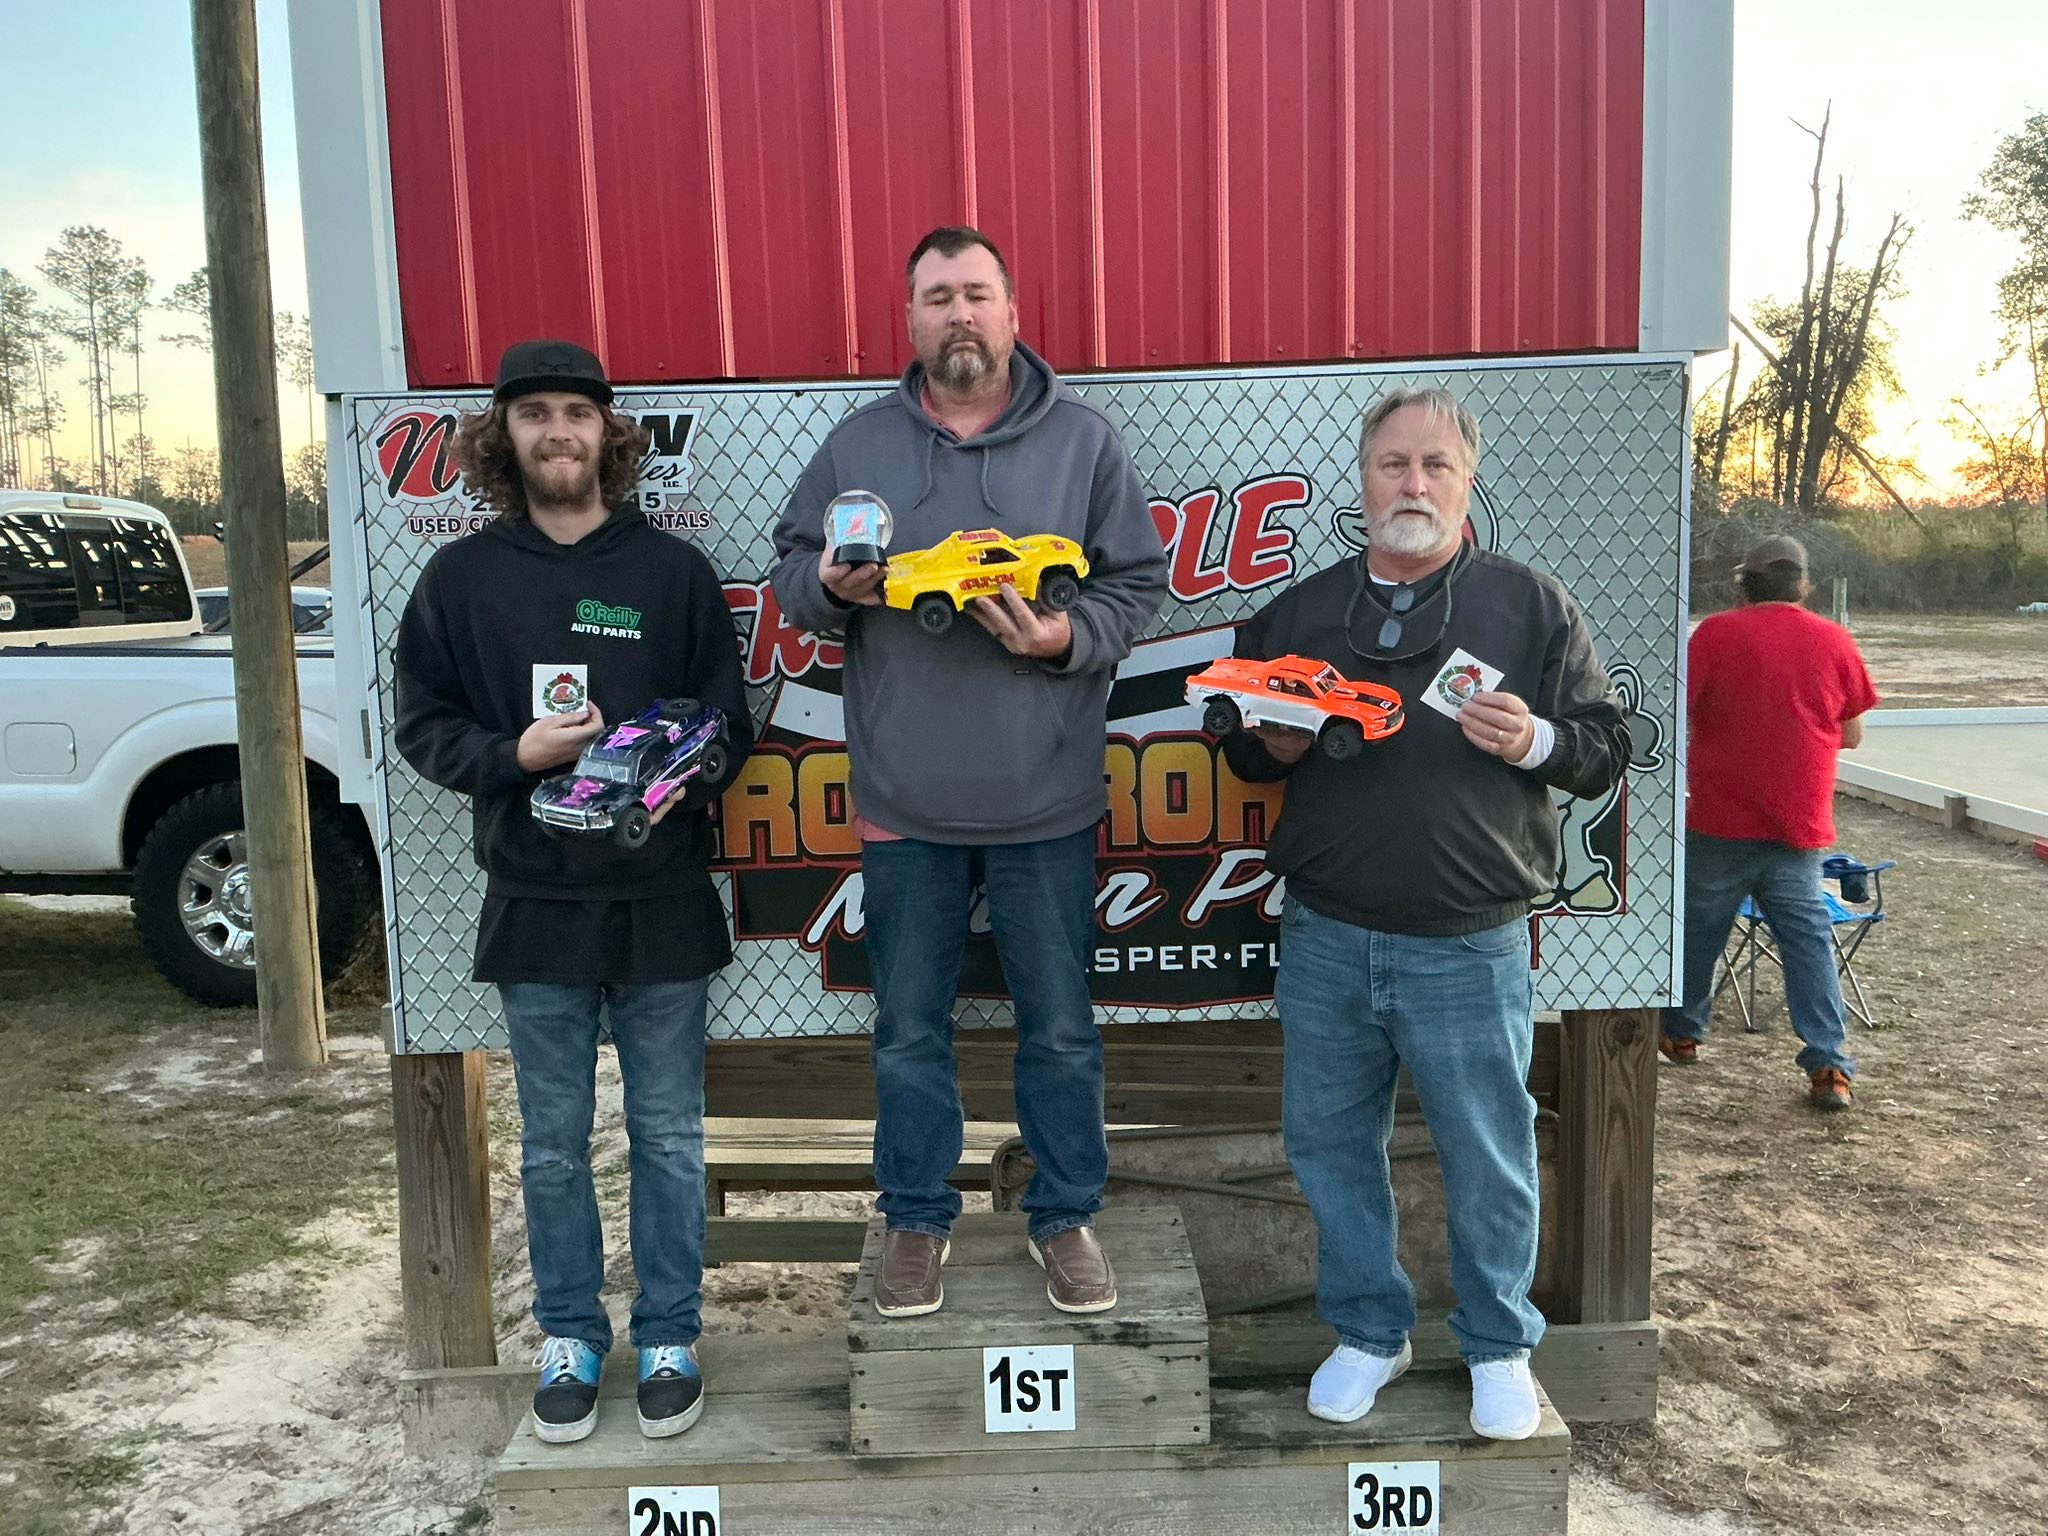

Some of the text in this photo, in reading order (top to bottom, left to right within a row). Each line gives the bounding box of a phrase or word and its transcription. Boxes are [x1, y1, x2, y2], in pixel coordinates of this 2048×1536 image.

[409, 518, 462, 533] USED
[648, 512, 711, 530] NTALS
[578, 601, 639, 628] O'Reilly
[570, 622, 642, 640] AUTO PARTS
[1086, 944, 1218, 973] SPER
[989, 1356, 1069, 1414] 1ST
[1353, 1473, 1433, 1530] 3RD
[634, 1497, 717, 1536] 2ND
